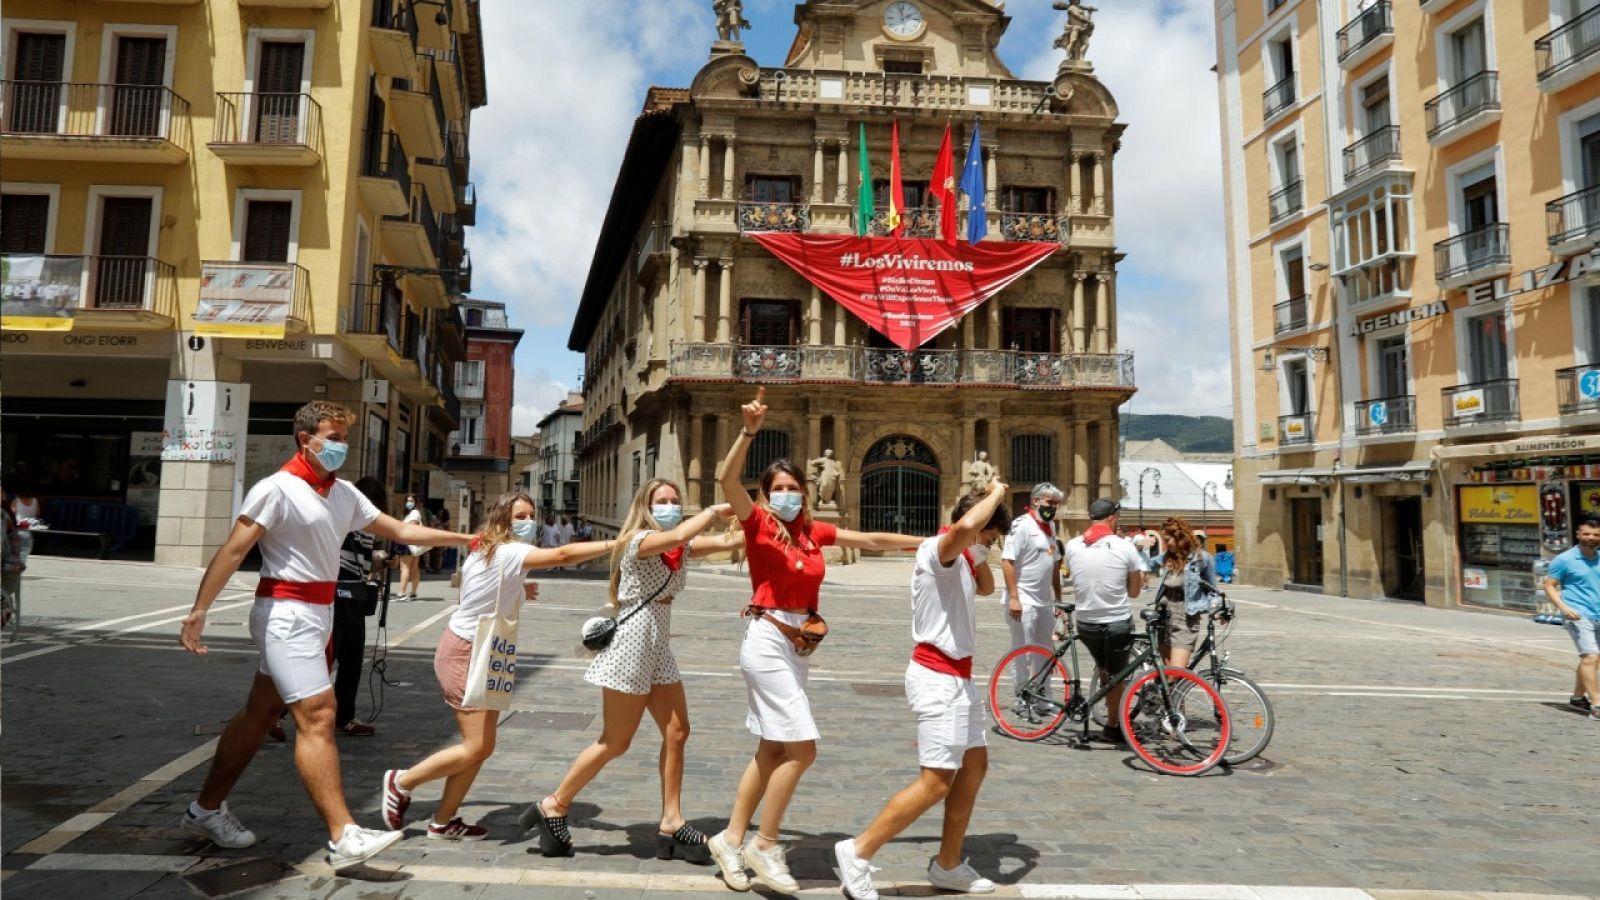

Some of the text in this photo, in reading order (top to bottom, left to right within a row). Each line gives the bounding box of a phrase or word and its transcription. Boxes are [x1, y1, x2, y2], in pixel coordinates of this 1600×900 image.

[840, 252, 974, 272] #LosViviremos
[1348, 300, 1449, 337] AGENCIA
[63, 334, 137, 346] ONGI ETORRI
[245, 339, 306, 351] BIENVENUE
